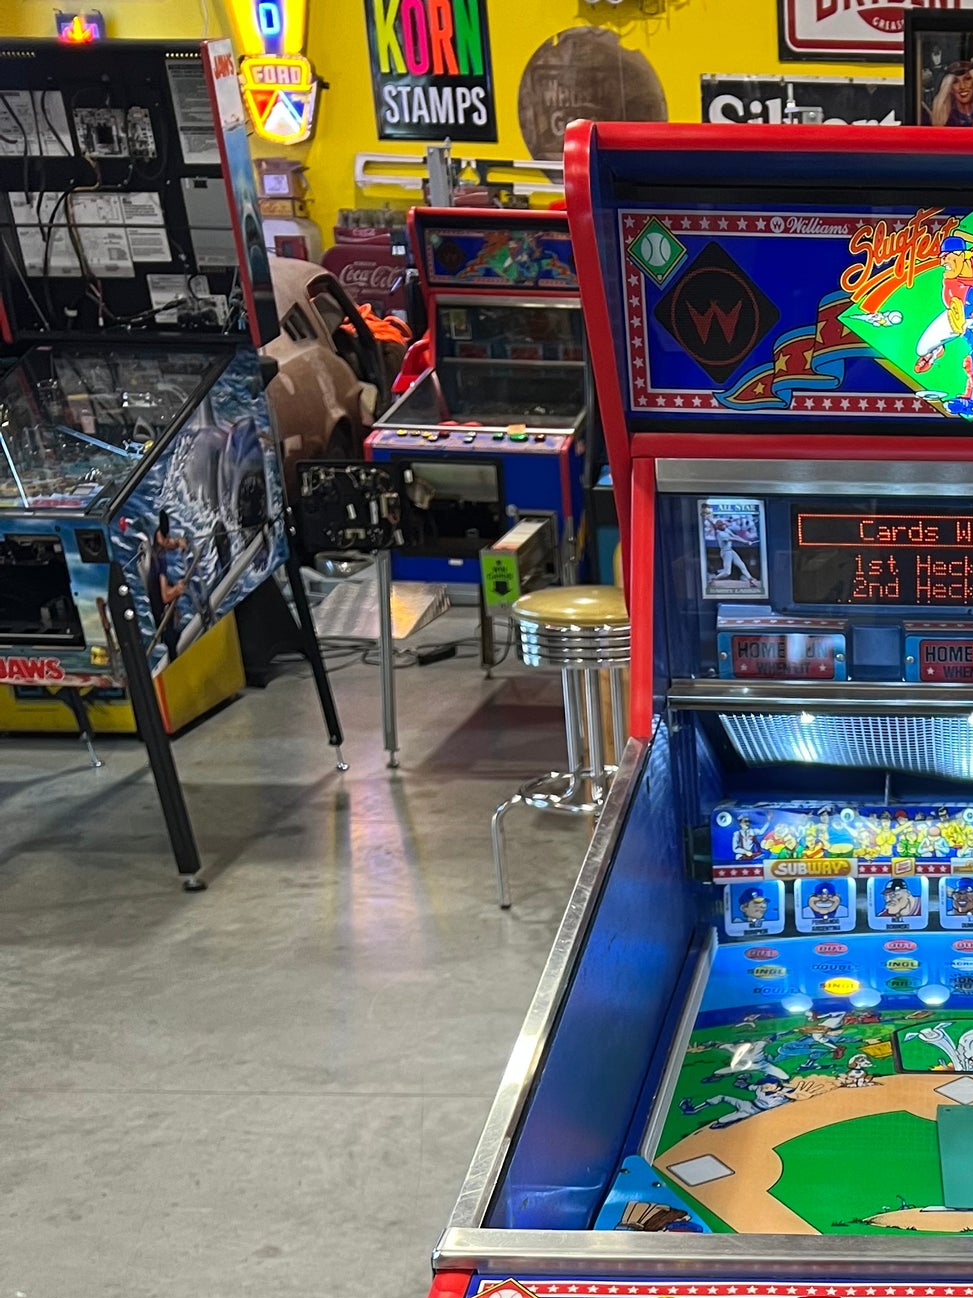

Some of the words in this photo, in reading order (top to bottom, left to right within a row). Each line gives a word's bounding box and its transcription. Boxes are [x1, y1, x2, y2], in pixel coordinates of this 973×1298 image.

[374, 0, 484, 76] KORN
[252, 65, 302, 84] FORD
[382, 84, 488, 126] STAMPS
[786, 217, 850, 235] Williams
[717, 504, 734, 512] ALL
[735, 504, 756, 512] STAR
[859, 520, 940, 543] Cards
[854, 554, 899, 576] 1st
[853, 577, 900, 598] 2nd
[738, 640, 786, 659] HOME
[774, 861, 843, 877] SUBWAY
